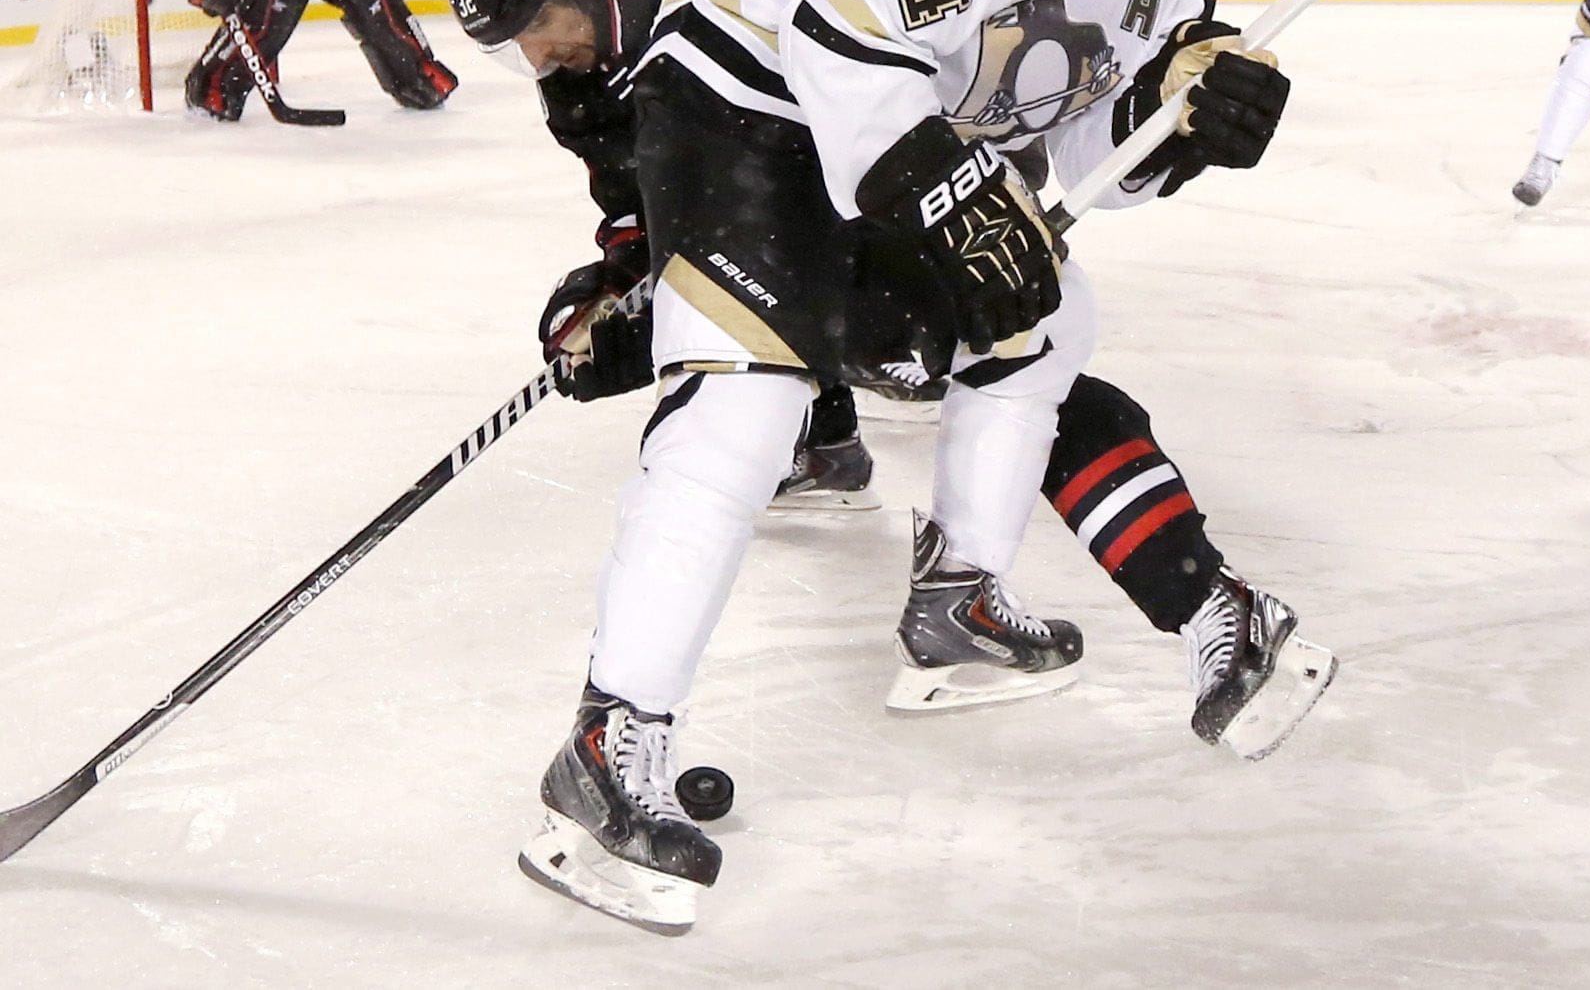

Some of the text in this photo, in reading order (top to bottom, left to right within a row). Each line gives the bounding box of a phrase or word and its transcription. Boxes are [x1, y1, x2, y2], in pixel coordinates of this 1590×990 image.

[225, 13, 276, 103] Reebok
[919, 140, 1001, 229] BAU
[707, 252, 779, 309] BAUER
[288, 553, 352, 615] COVERT
